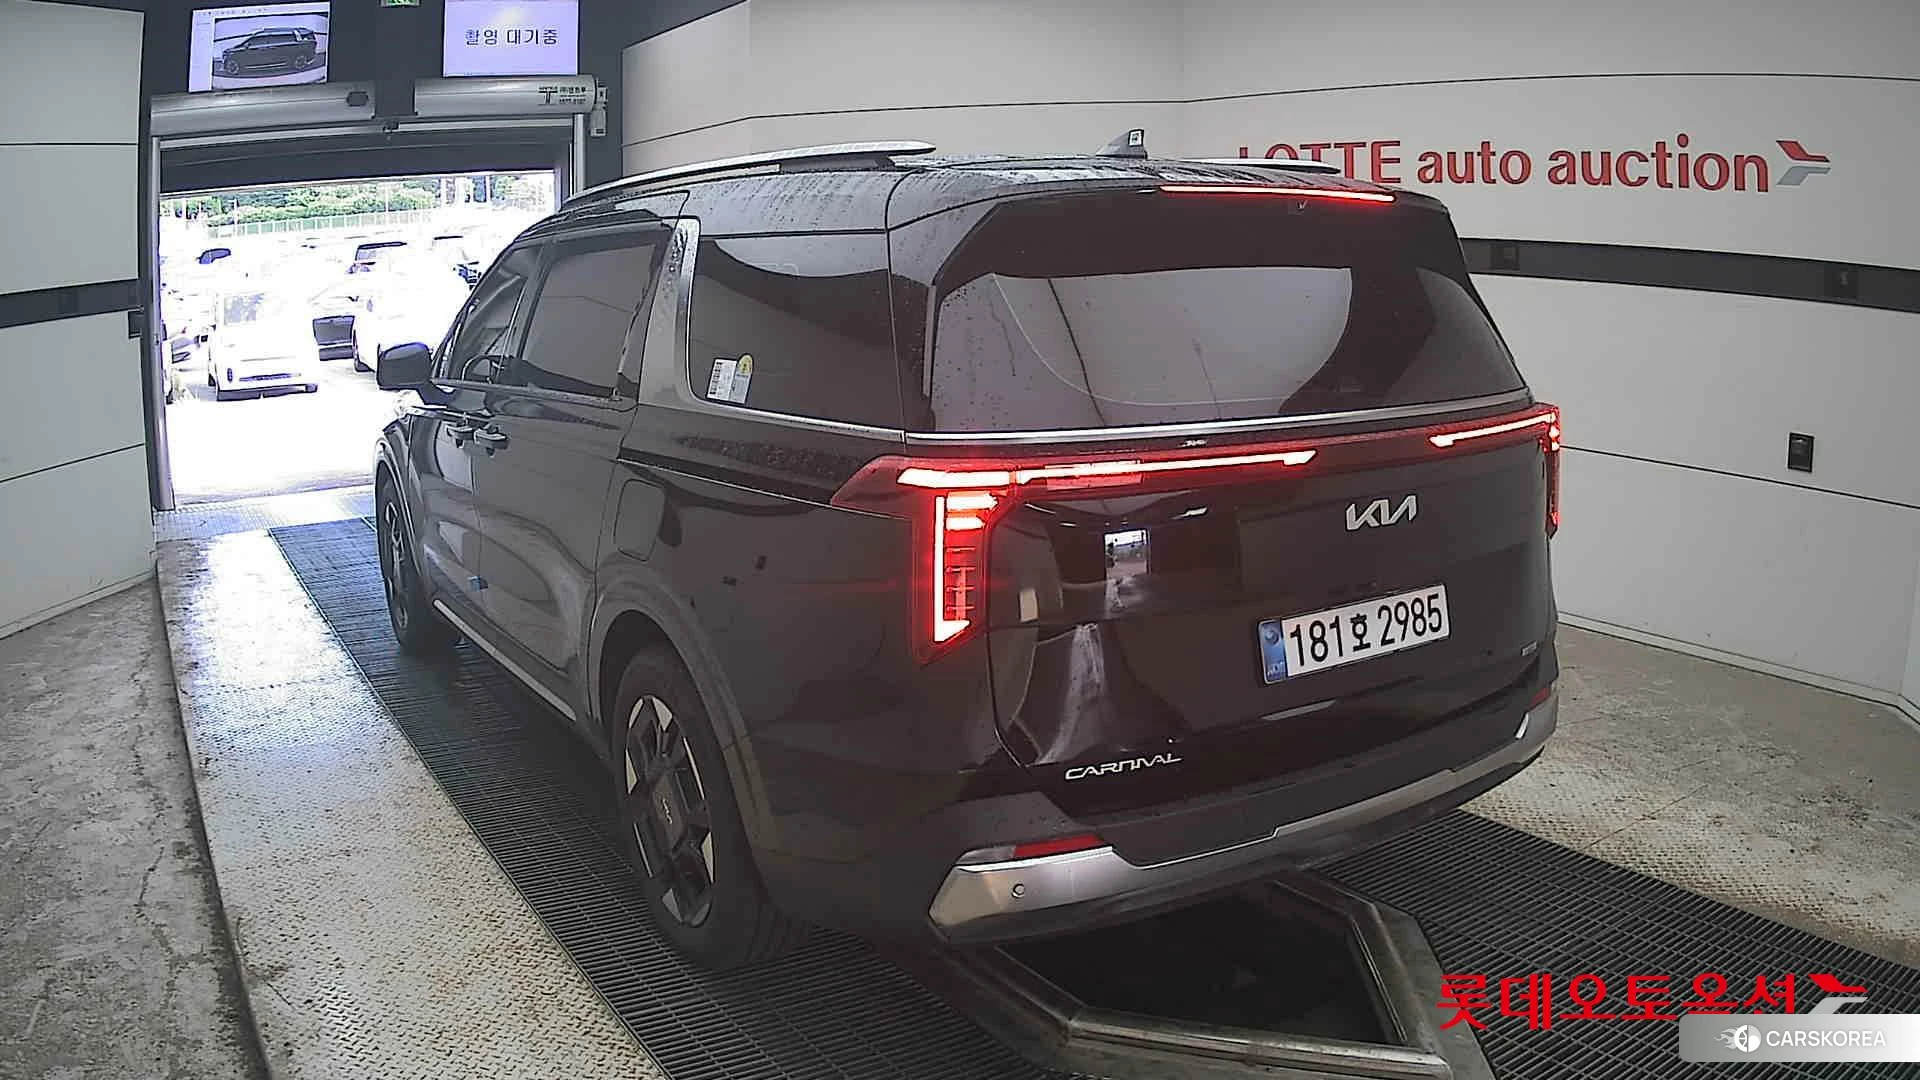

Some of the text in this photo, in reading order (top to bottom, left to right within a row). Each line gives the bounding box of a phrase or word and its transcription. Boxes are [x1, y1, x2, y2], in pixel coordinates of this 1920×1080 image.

[507, 29, 559, 45] 대기중
[1239, 133, 1769, 193] TTE auto auction
[1377, 594, 1443, 647] 2985
[1065, 753, 1182, 780] CARNIVAL
